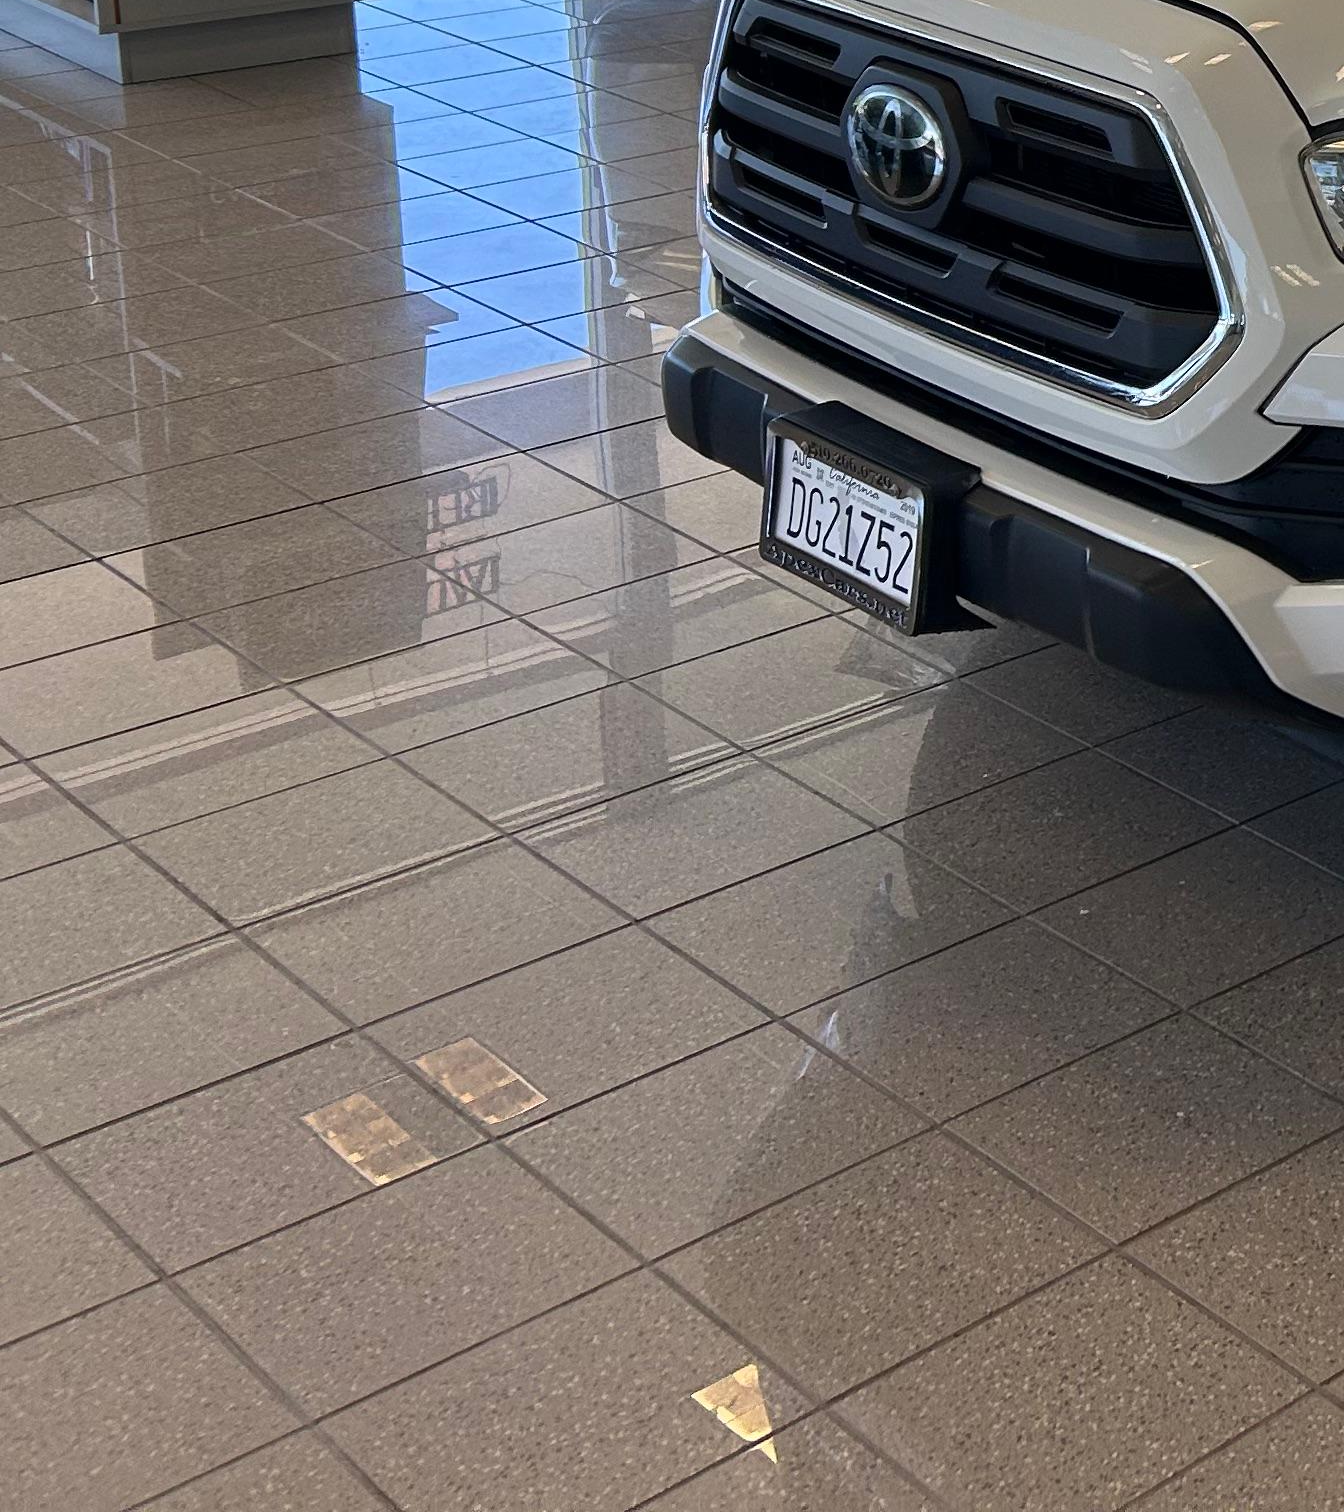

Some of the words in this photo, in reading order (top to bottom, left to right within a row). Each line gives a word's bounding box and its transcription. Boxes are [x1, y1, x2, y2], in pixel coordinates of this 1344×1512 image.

[791, 450, 812, 470] AUG
[829, 467, 880, 501] California
[787, 476, 914, 595] DG21Z52
